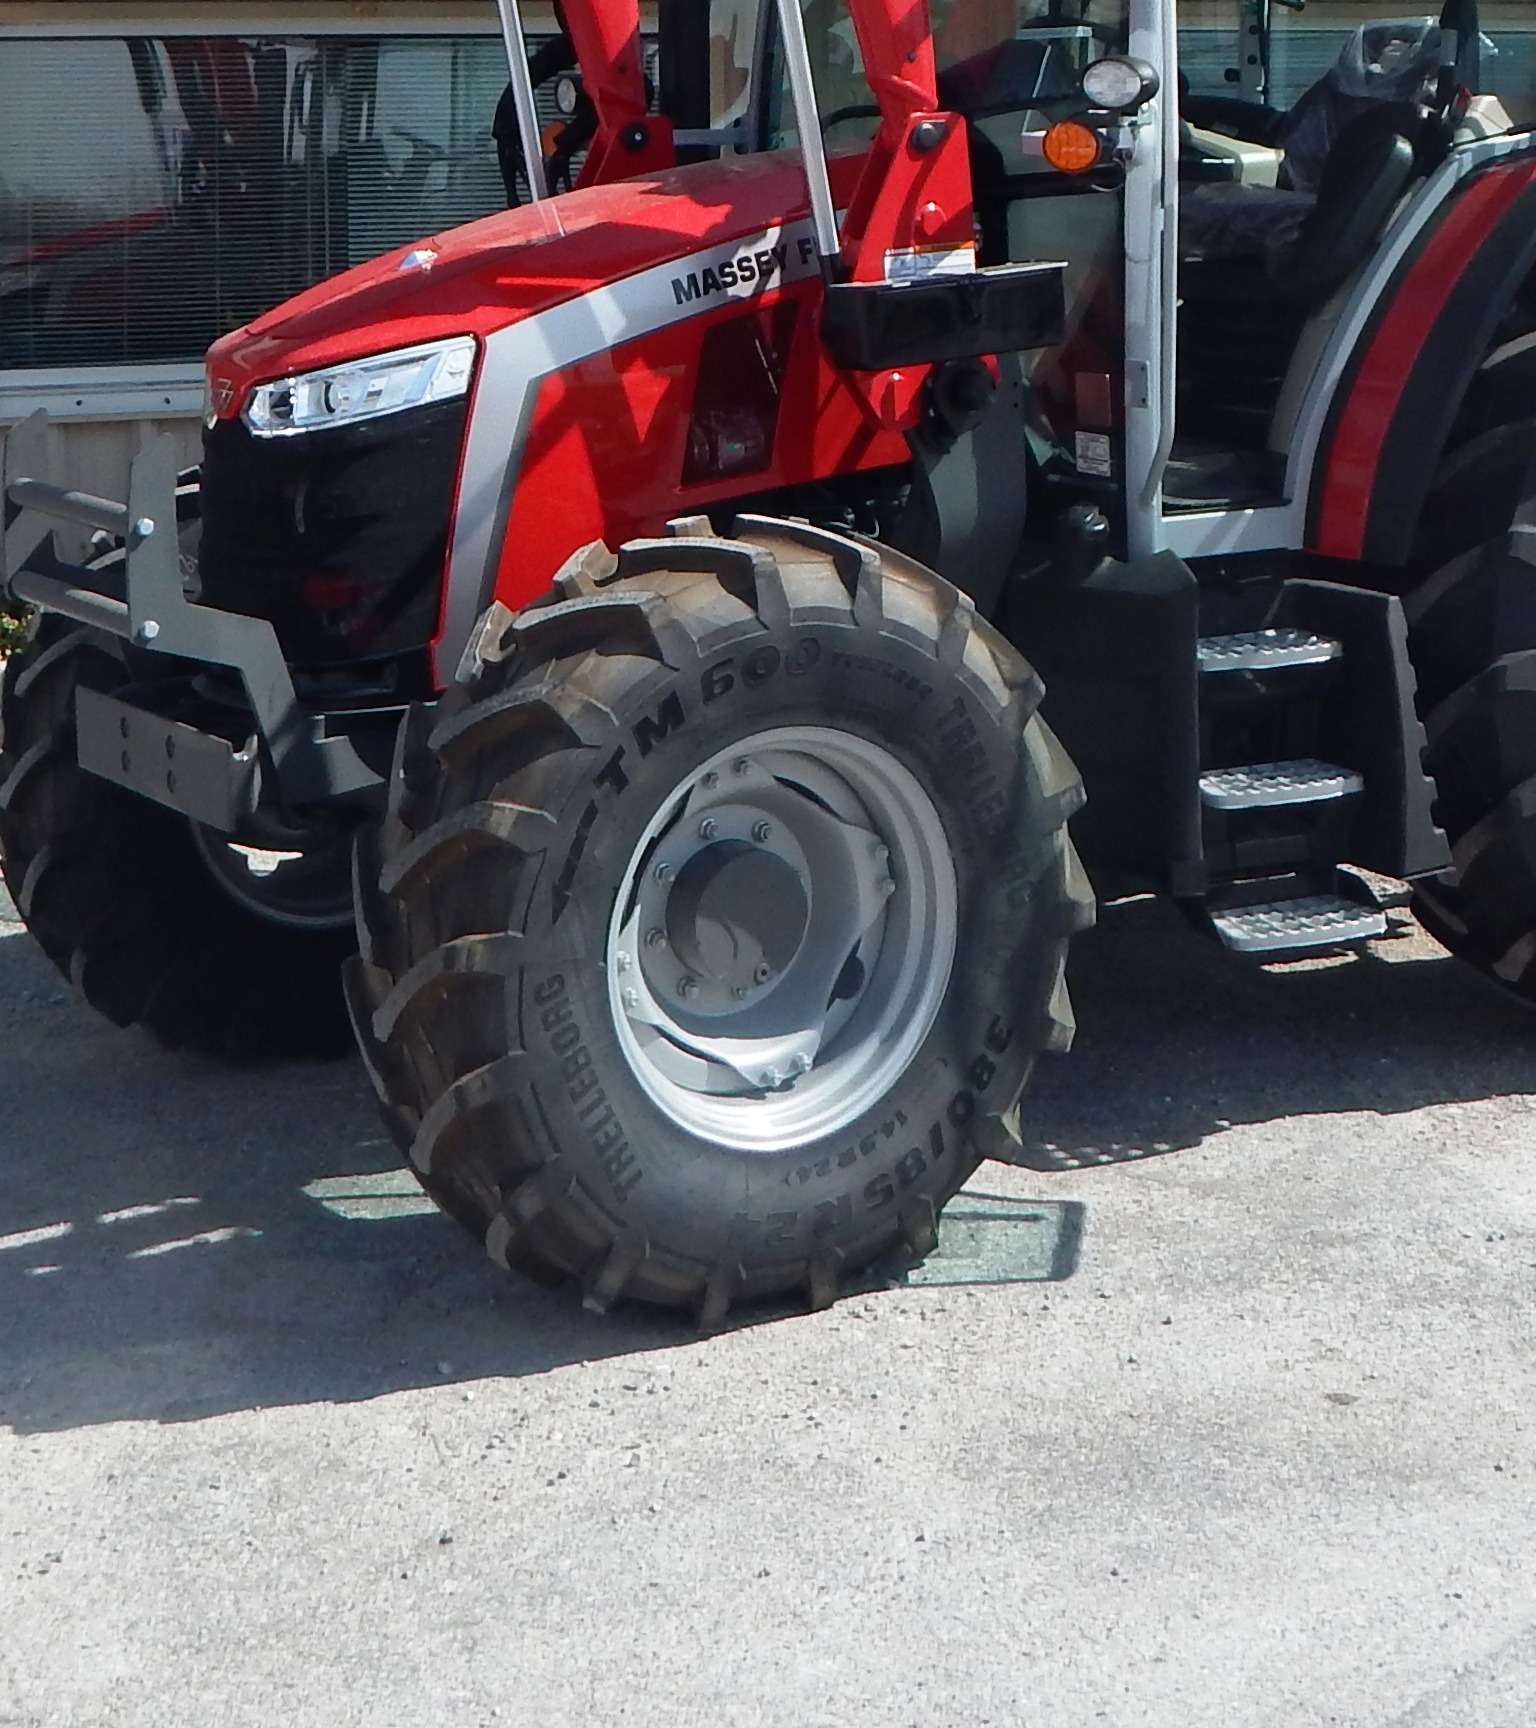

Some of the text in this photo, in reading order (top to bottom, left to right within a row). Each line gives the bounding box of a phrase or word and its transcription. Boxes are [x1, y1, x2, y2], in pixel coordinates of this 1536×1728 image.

[670, 243, 788, 305] MASSEY
[593, 689, 686, 795] TM
[533, 972, 645, 1204] TRELLEBORG
